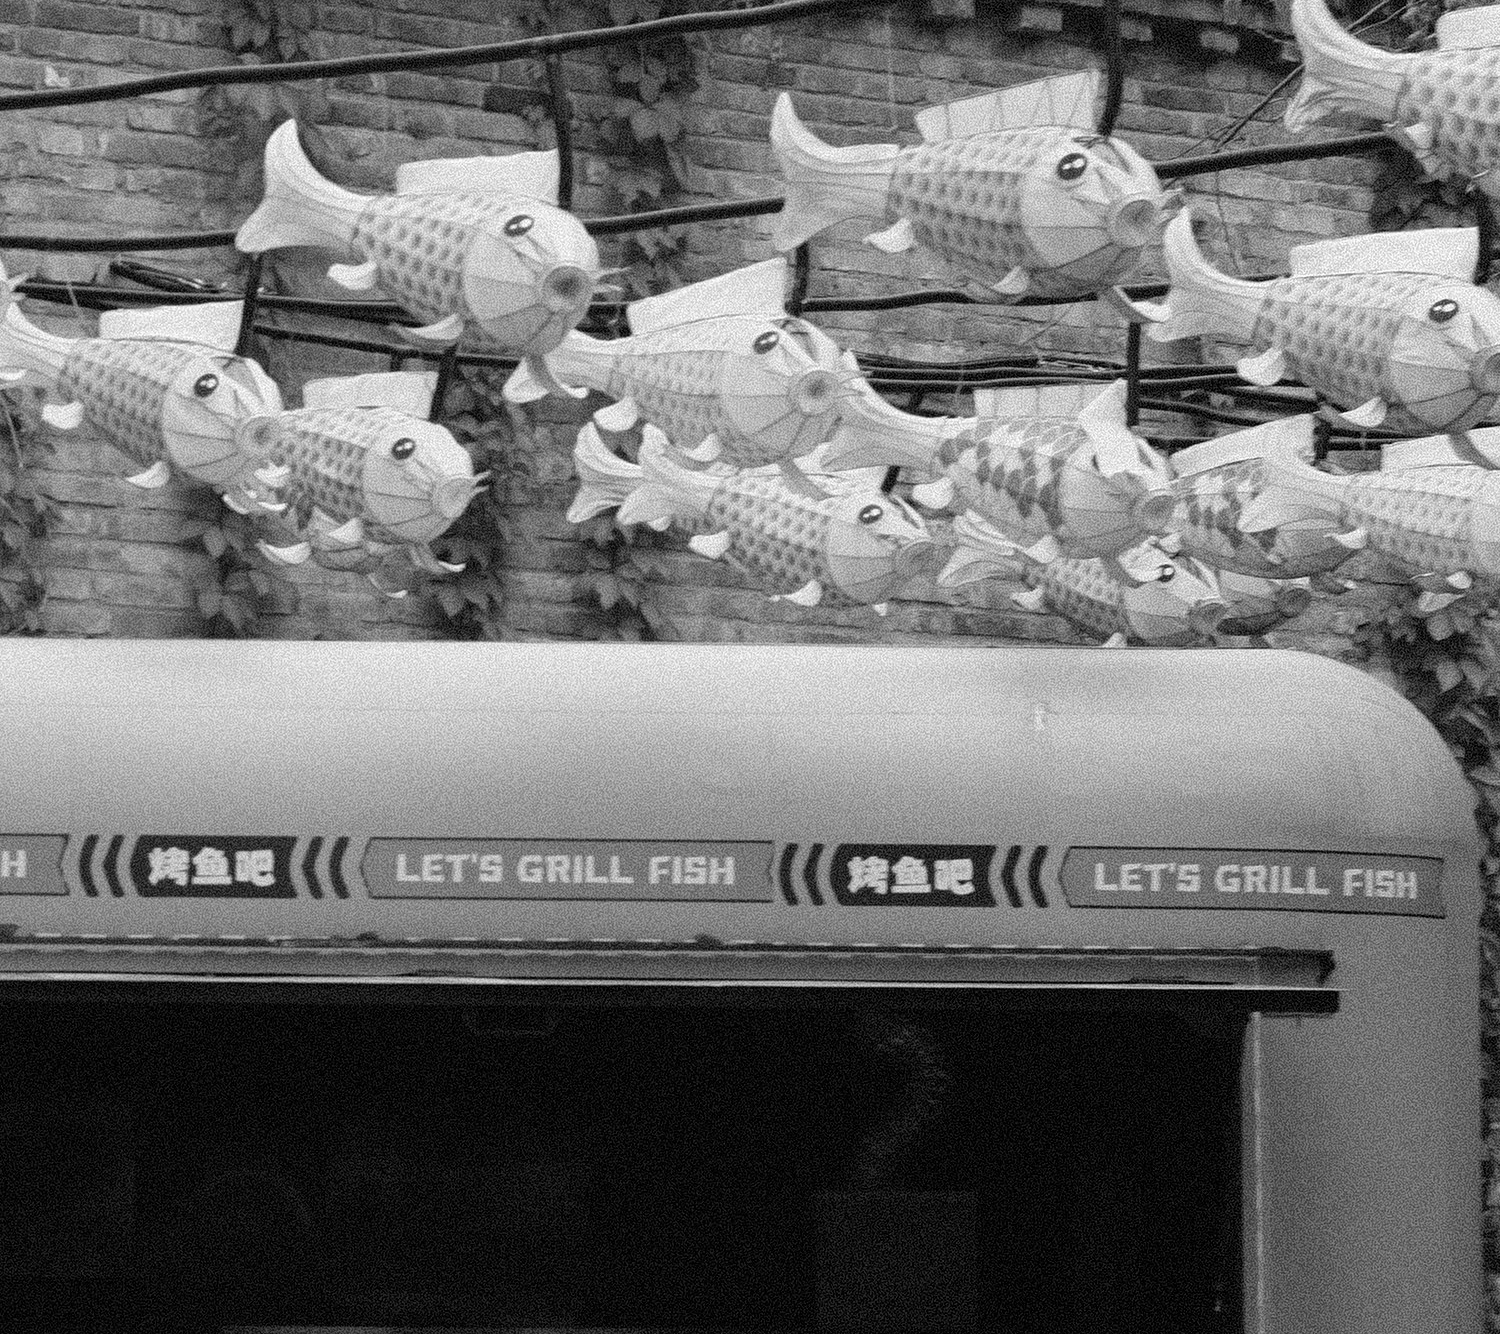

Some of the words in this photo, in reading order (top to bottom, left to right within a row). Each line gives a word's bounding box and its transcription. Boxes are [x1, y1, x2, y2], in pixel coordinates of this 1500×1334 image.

[147, 846, 276, 887] 烤鱼吧
[396, 853, 504, 883] LET'S
[516, 854, 634, 885] GRILL
[648, 855, 735, 885] FISH
[847, 855, 975, 896] 烤鱼吧
[1093, 861, 1202, 893] LET'S
[1214, 863, 1330, 896] GRILL
[1343, 867, 1418, 899] FISH
